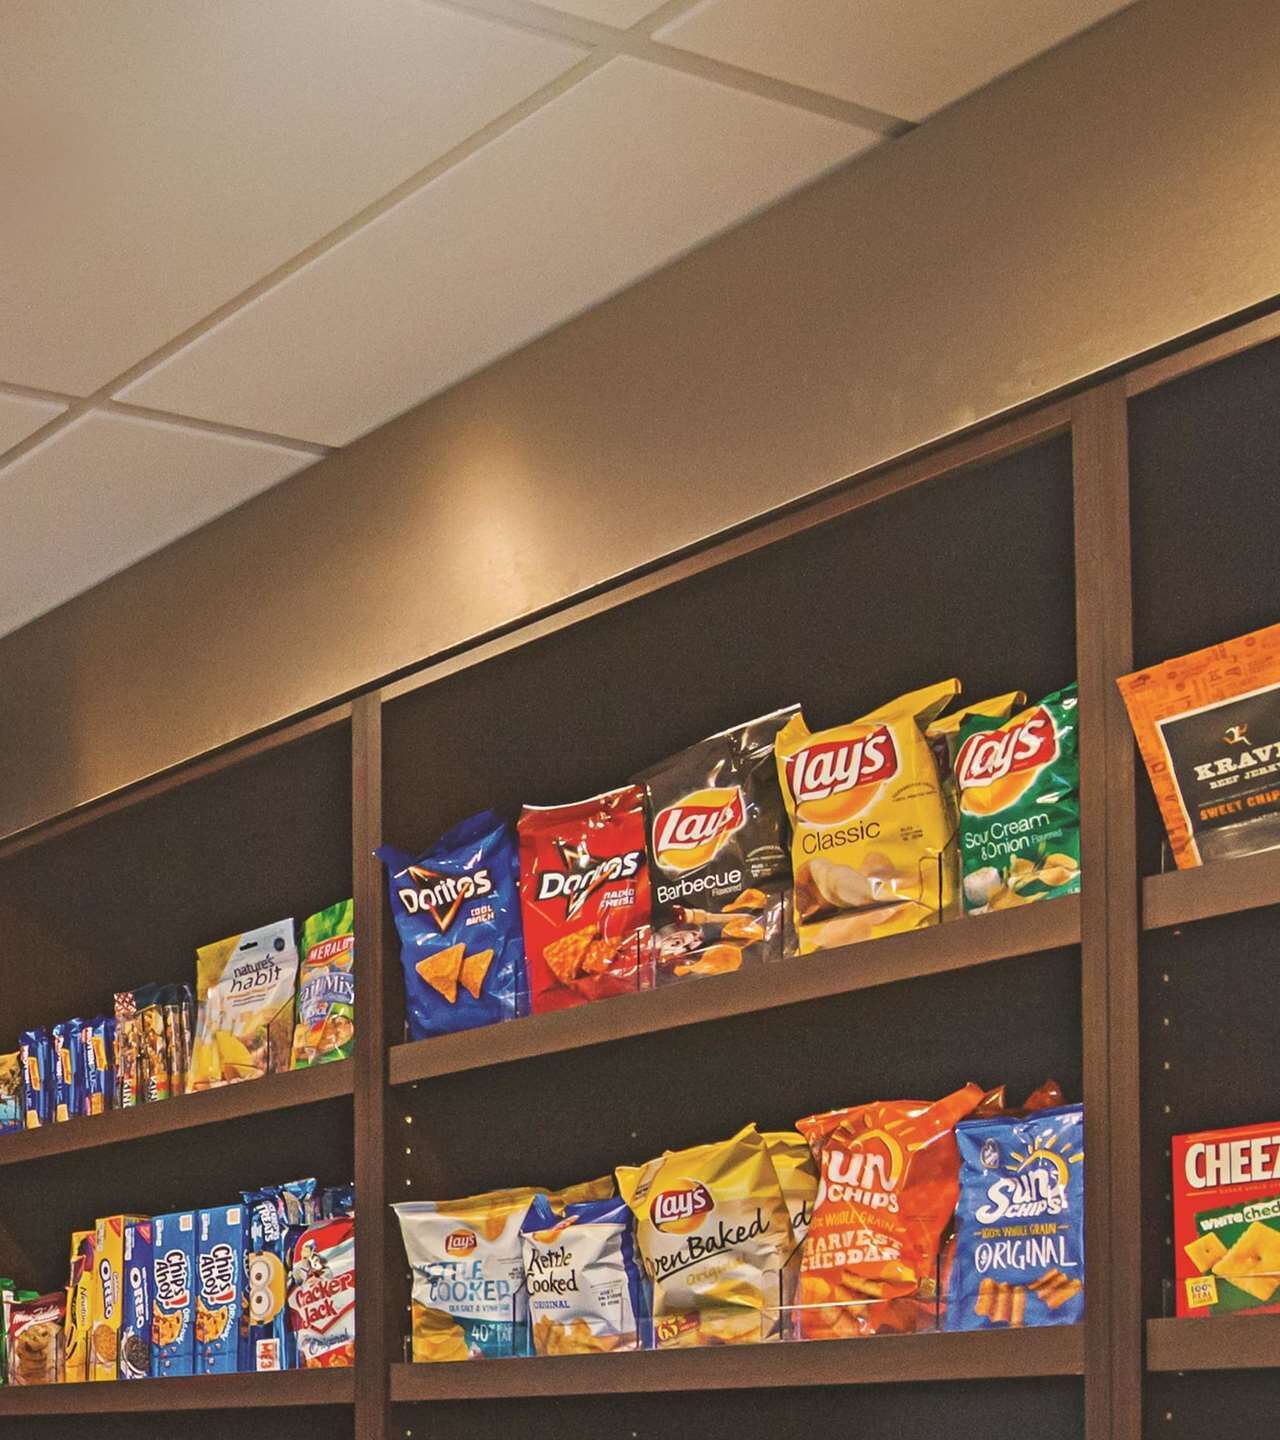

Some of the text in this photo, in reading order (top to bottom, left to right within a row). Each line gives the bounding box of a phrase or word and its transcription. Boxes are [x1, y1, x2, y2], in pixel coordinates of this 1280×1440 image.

[794, 731, 887, 804] Lay's
[960, 713, 1045, 789] Lay's
[1193, 744, 1280, 781] KRAV
[1210, 774, 1239, 790] BEEF
[1199, 796, 1243, 821] SWEET
[802, 820, 882, 855] Classic
[965, 812, 1050, 850] Sour Cream
[989, 834, 1030, 857] Onion
[399, 869, 492, 914] Doritos
[539, 851, 639, 901] Doritos
[657, 869, 742, 905] Barbecue
[230, 966, 282, 992] habit
[234, 953, 275, 978] nature's
[654, 1186, 707, 1223] Lay's
[828, 1184, 899, 1213] CHIPS
[975, 1168, 1056, 1225] Sun
[1006, 1197, 1063, 1219] CHIPS
[446, 1233, 476, 1251] Lay's
[1002, 1223, 1057, 1237] WHOLE GRAIN
[212, 1246, 233, 1291] Chips
[529, 1246, 573, 1274] Kettle
[975, 1236, 1078, 1273] ORIGINAL
[100, 1259, 113, 1319] OREO
[165, 1252, 185, 1297] Chips
[526, 1270, 578, 1296] Cooked
[130, 1266, 145, 1328] OREO
[303, 1300, 337, 1329] Jack
